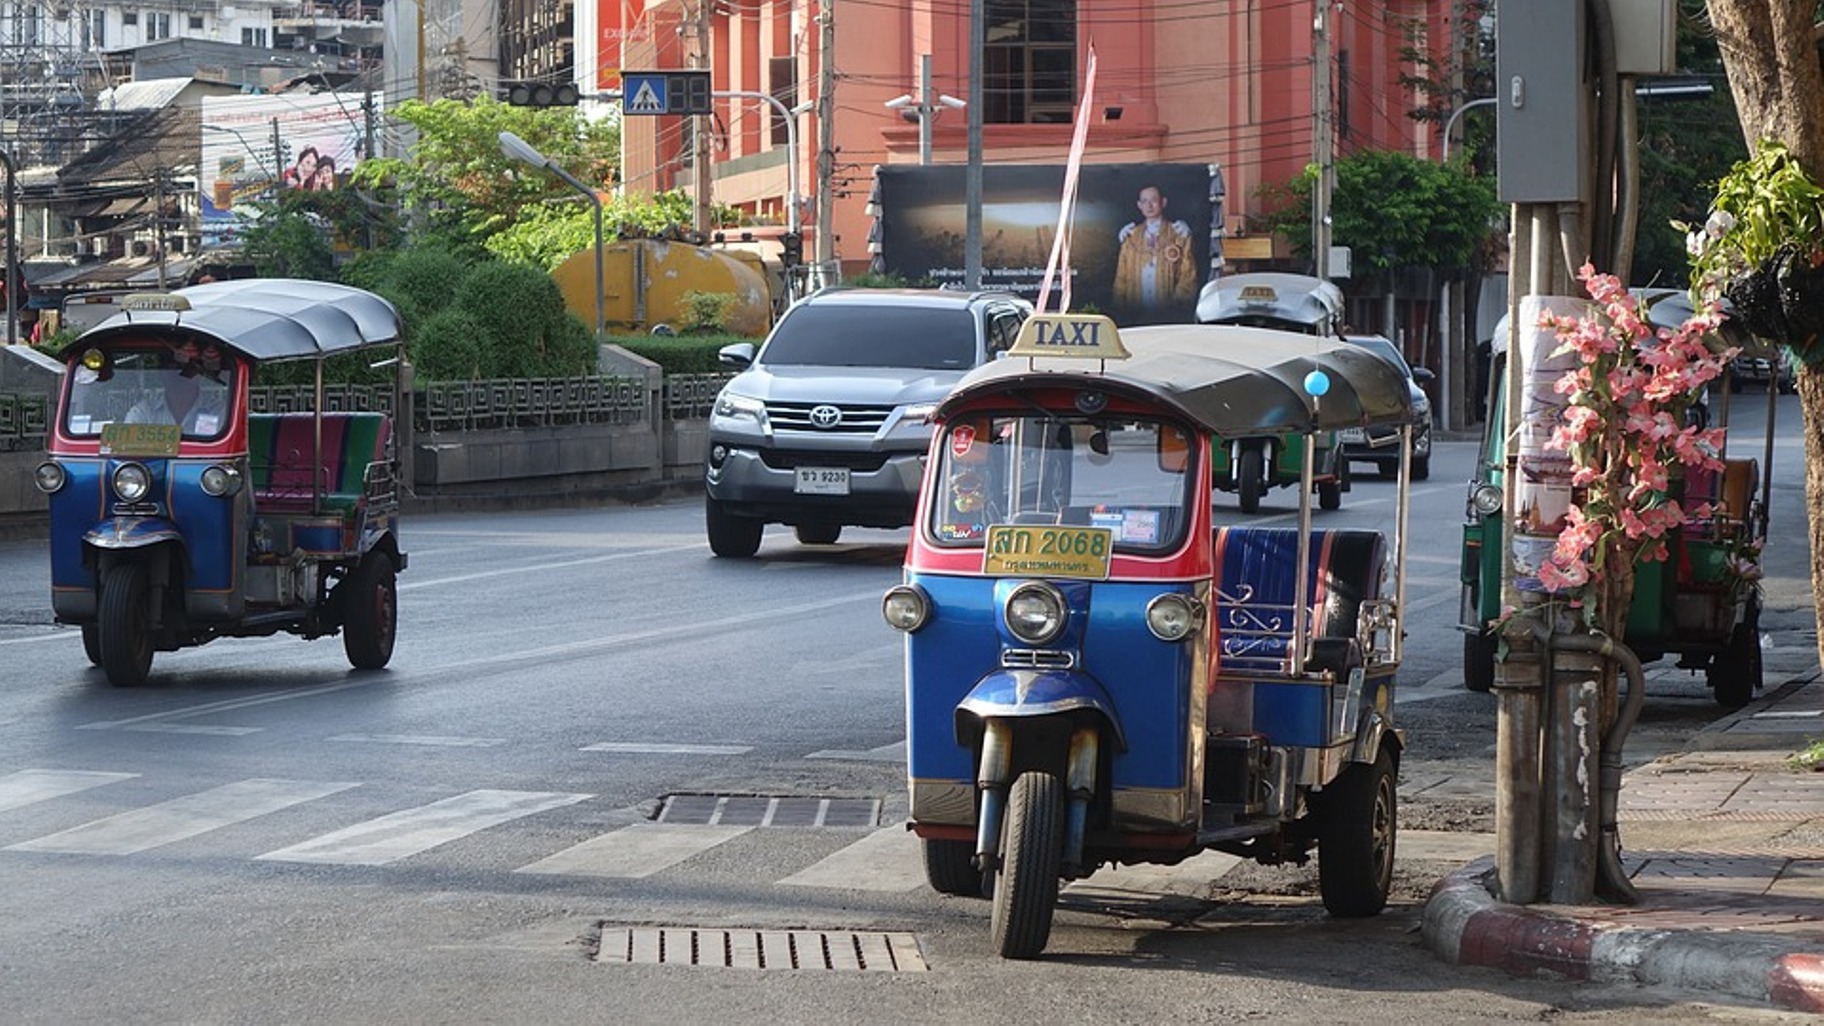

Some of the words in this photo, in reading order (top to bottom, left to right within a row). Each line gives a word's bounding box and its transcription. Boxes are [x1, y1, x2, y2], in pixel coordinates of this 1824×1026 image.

[1033, 320, 1101, 346] TAXI
[993, 528, 1030, 554] สก
[1038, 530, 1106, 557] 2068
